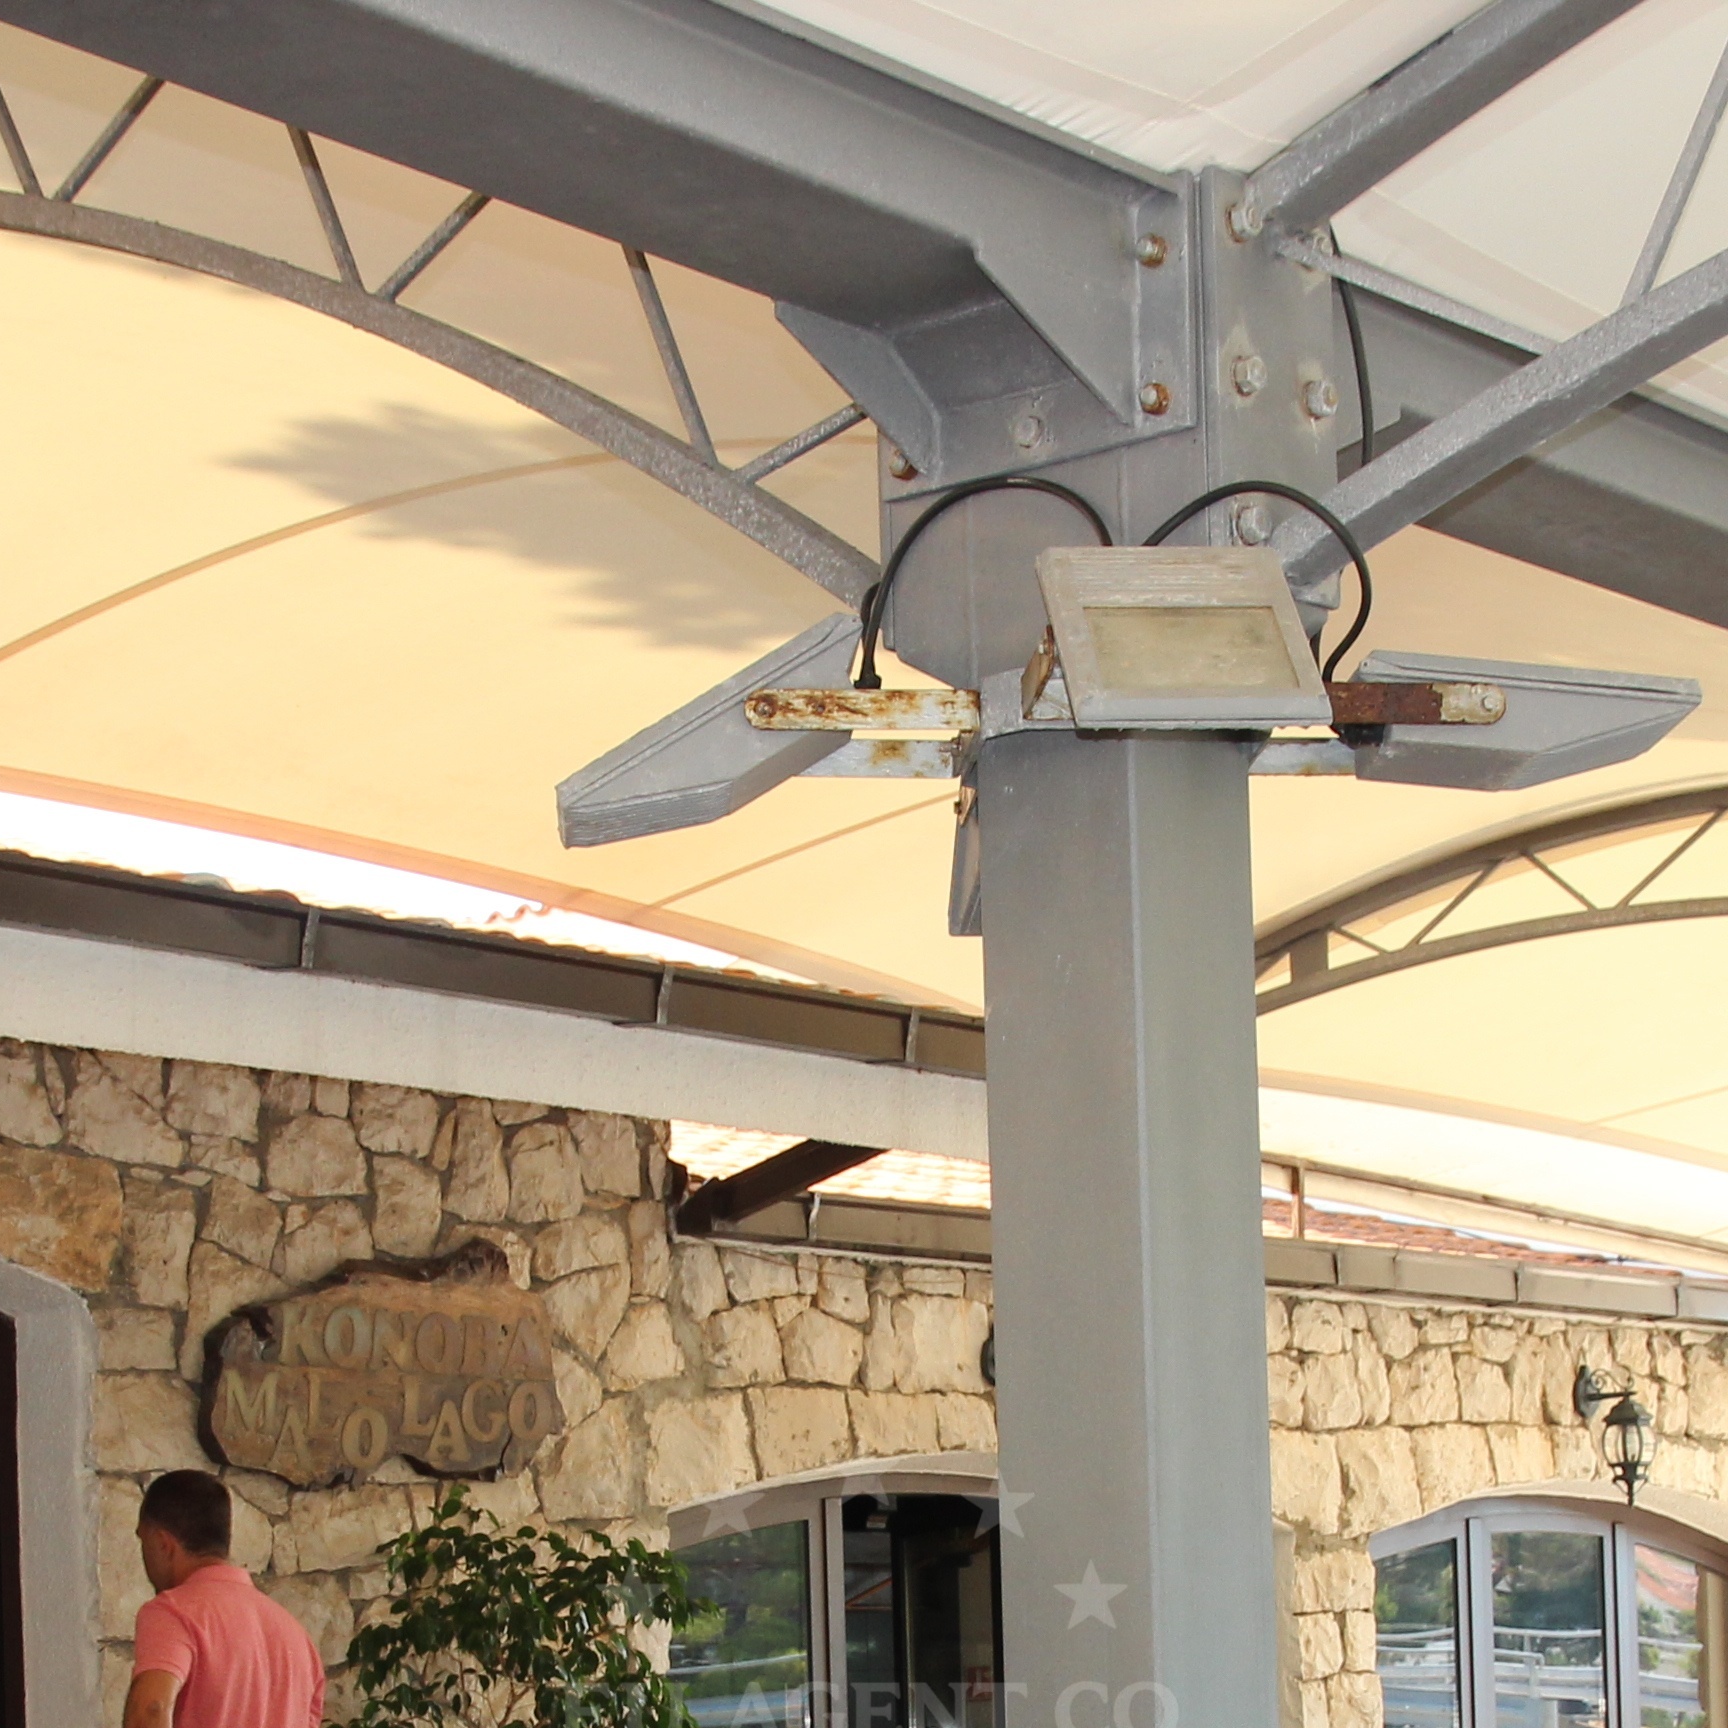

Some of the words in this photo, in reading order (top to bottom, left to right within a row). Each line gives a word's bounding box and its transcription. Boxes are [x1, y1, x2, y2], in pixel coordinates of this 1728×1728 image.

[277, 1304, 551, 1381] KONOBA
[223, 1368, 389, 1469] MALO
[401, 1375, 553, 1463] LAGO
